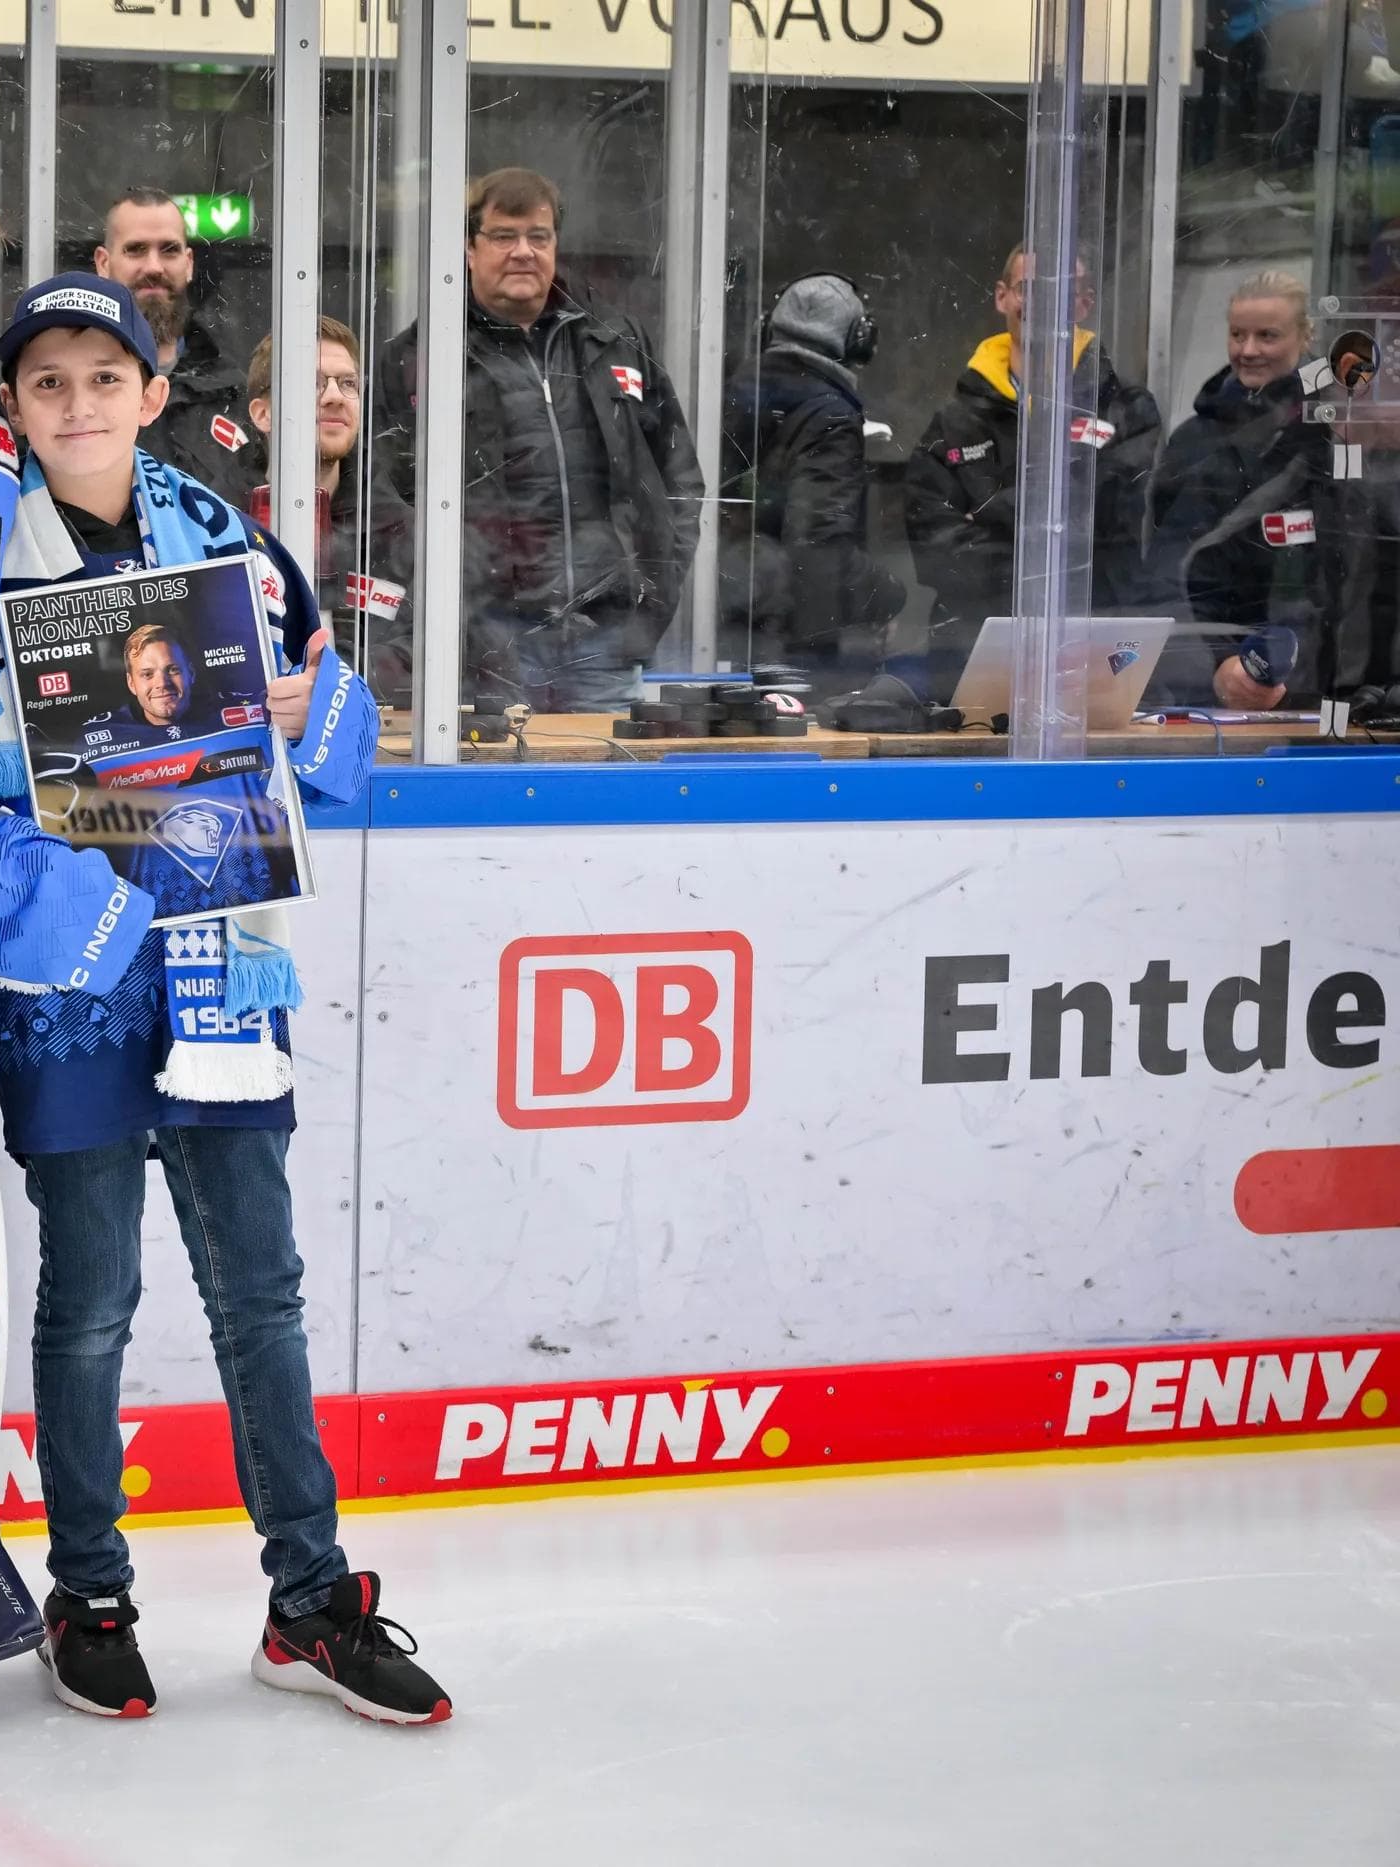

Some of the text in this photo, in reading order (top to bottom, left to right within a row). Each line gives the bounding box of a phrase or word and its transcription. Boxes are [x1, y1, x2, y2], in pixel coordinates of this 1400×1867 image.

[46, 291, 74, 303] UNSER
[77, 292, 103, 304] STOLZ
[46, 300, 116, 318] INGOLSTADT
[11, 577, 188, 623] PANTHER DES
[15, 610, 131, 647] MONATS
[19, 642, 93, 665] OKTOBER
[204, 645, 246, 658] MICHAEL
[205, 654, 246, 668] GARTEIG
[43, 676, 67, 693] DB
[26, 692, 89, 710] Regio Bayern
[88, 731, 110, 743] DB
[99, 740, 140, 754] Bayern
[219, 754, 257, 770] SATURN
[175, 979, 215, 998] NUR
[921, 939, 1388, 1085] Entde
[532, 963, 722, 1098] DB
